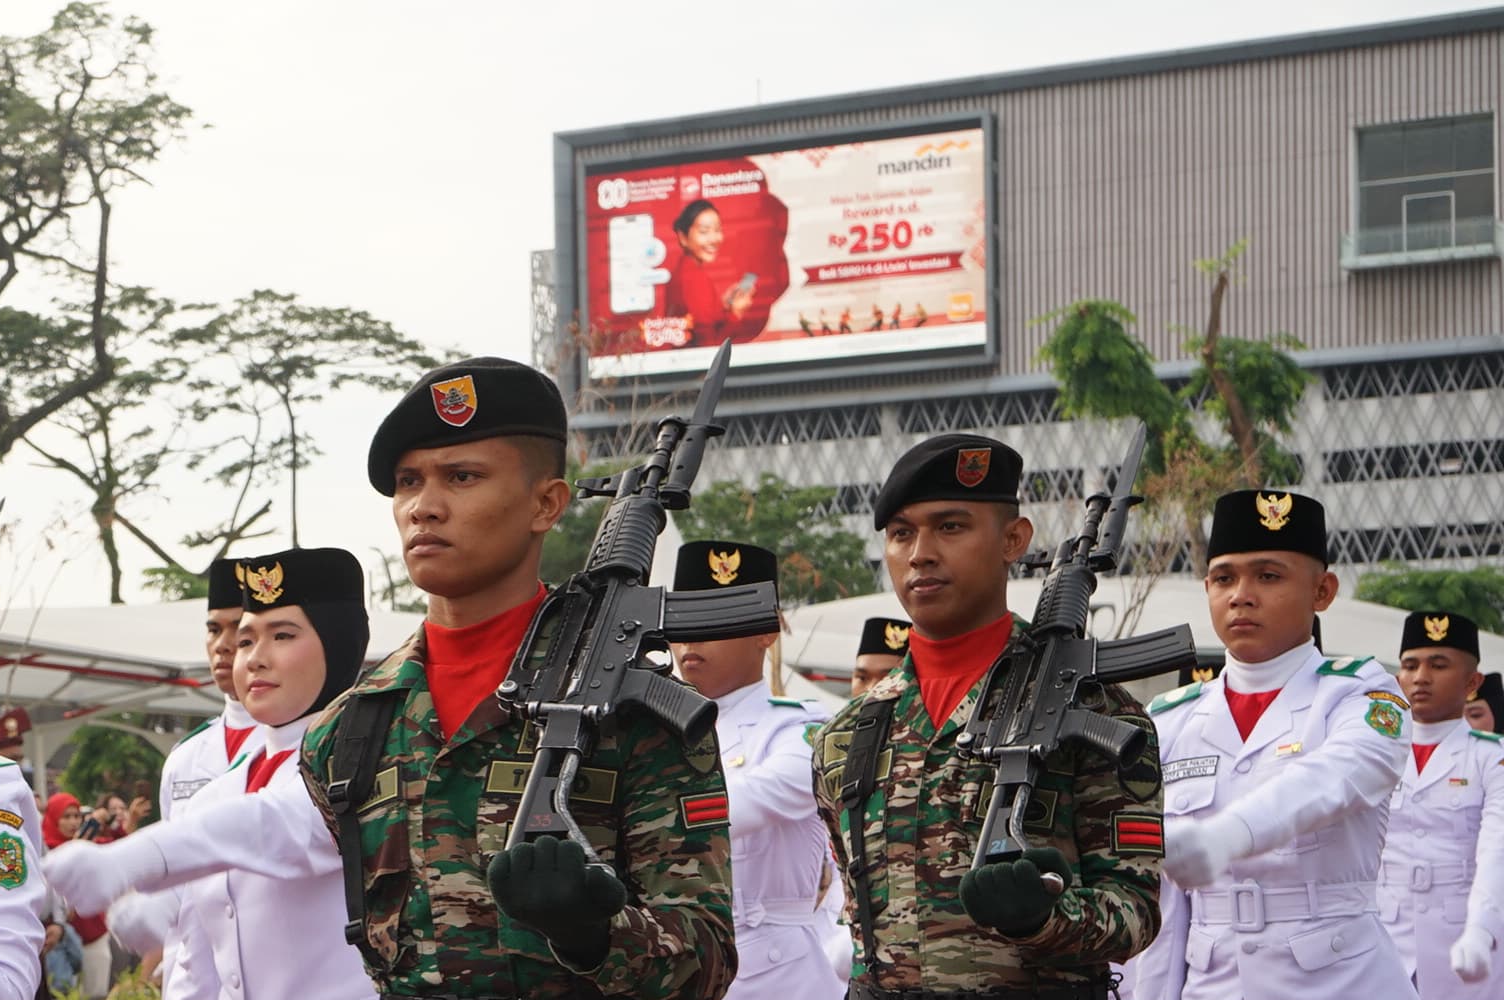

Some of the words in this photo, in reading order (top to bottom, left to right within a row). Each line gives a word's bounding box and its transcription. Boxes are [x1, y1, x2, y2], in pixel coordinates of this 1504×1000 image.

[877, 154, 951, 175] mandiri
[828, 234, 847, 248] Rp
[848, 220, 913, 255] 250
[990, 840, 1007, 854] 21
